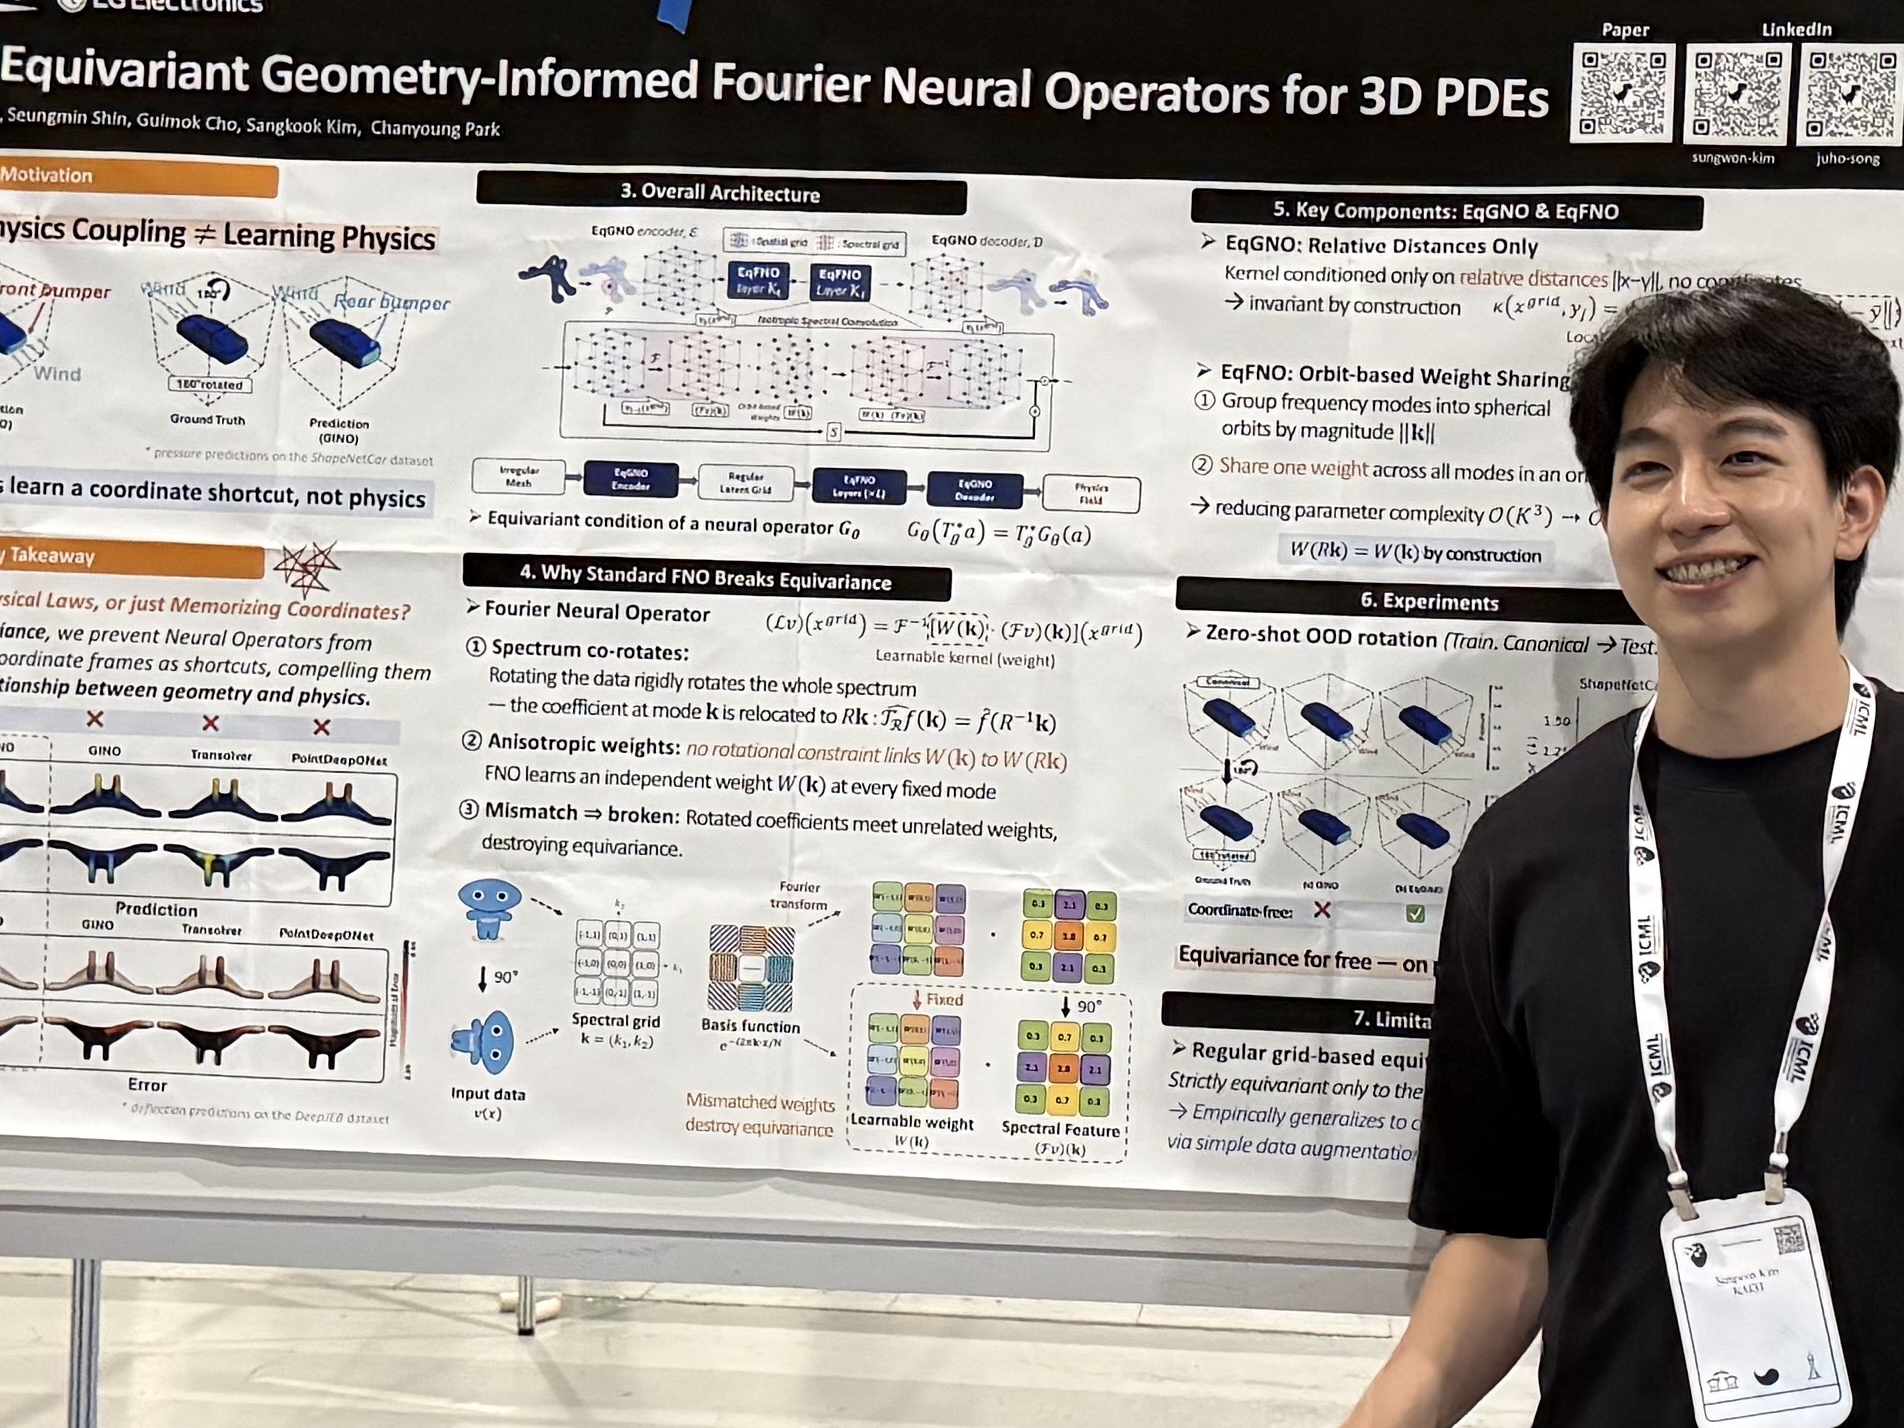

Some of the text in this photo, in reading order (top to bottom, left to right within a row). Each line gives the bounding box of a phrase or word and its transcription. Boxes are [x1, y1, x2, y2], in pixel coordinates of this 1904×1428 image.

[1602, 22, 1650, 40] Paper
[1763, 21, 1832, 37] LinkedIn
[0, 44, 249, 92] Equivariant
[261, 53, 698, 99] Geometry-Informed
[713, 62, 871, 103] Fourier
[883, 66, 1031, 108] Neural
[1045, 71, 1270, 114] Operators
[1282, 72, 1348, 115] for
[1360, 75, 1422, 115] 3D
[1436, 77, 1549, 118] PDEs
[7, 107, 87, 126] Seungmin
[91, 110, 131, 128] Shin,
[205, 116, 241, 134] Cho,
[246, 117, 321, 136] Sangkook
[326, 118, 361, 137] Kim,
[371, 119, 460, 140] Chanyoung
[465, 121, 500, 137] Park
[0, 166, 92, 184] Motivation
[620, 182, 820, 203] 3. Overall Architecture
[1273, 201, 1619, 223] 5. Key Components: EqGNO & EqFNO
[72, 217, 187, 248] Coupling
[224, 221, 335, 253] Learning
[342, 224, 435, 254] Physics
[1226, 234, 1538, 259] EqGNO: Relative Distances Only
[1222, 363, 1573, 394] EqFNO: Orbit-based Weight Sharing
[10, 475, 64, 496] learn
[71, 482, 82, 496] a
[90, 480, 202, 501] coordinate
[208, 482, 299, 507] shortcut,
[307, 489, 343, 505] not
[349, 487, 425, 511] physics
[11, 546, 95, 567] Takeaway
[520, 563, 892, 592] 4. Why Standard FNO Breaks Equivariance
[46, 592, 98, 612] Laws,
[105, 598, 125, 612] or
[129, 594, 165, 614] just
[170, 596, 281, 620] Memorizing
[287, 599, 411, 620] Coordinates?
[485, 600, 710, 624] Fourier Neural Operator
[1361, 591, 1499, 612] 6. Experiments
[58, 628, 84, 641] we
[88, 629, 160, 645] prevent
[164, 628, 227, 646] Neural
[232, 631, 323, 650] Operators
[325, 633, 372, 654] from
[1206, 624, 1437, 648] Zero-shot OOD rotation
[492, 638, 688, 661] Spectrum co-rotates:
[1854, 701, 1871, 737] ICML
[488, 733, 680, 758] Anisotropic weights:
[1832, 804, 1851, 845] ICML
[1638, 915, 1651, 956] ICML
[1178, 945, 1427, 973] Equivariance for free on
[572, 1012, 660, 1030] Spectral grid
[702, 1018, 800, 1034] Basis function
[1354, 1010, 1431, 1029] 7. Limita
[1193, 1041, 1267, 1063] Regular
[1272, 1045, 1375, 1066] grid-based
[1647, 1033, 1661, 1078] ICML
[1790, 1040, 1814, 1084] ICML
[128, 1077, 167, 1092] Error
[451, 1087, 525, 1101] Input data
[686, 1092, 836, 1115] Mismatched weights
[685, 1116, 833, 1137] destroy equivariance
